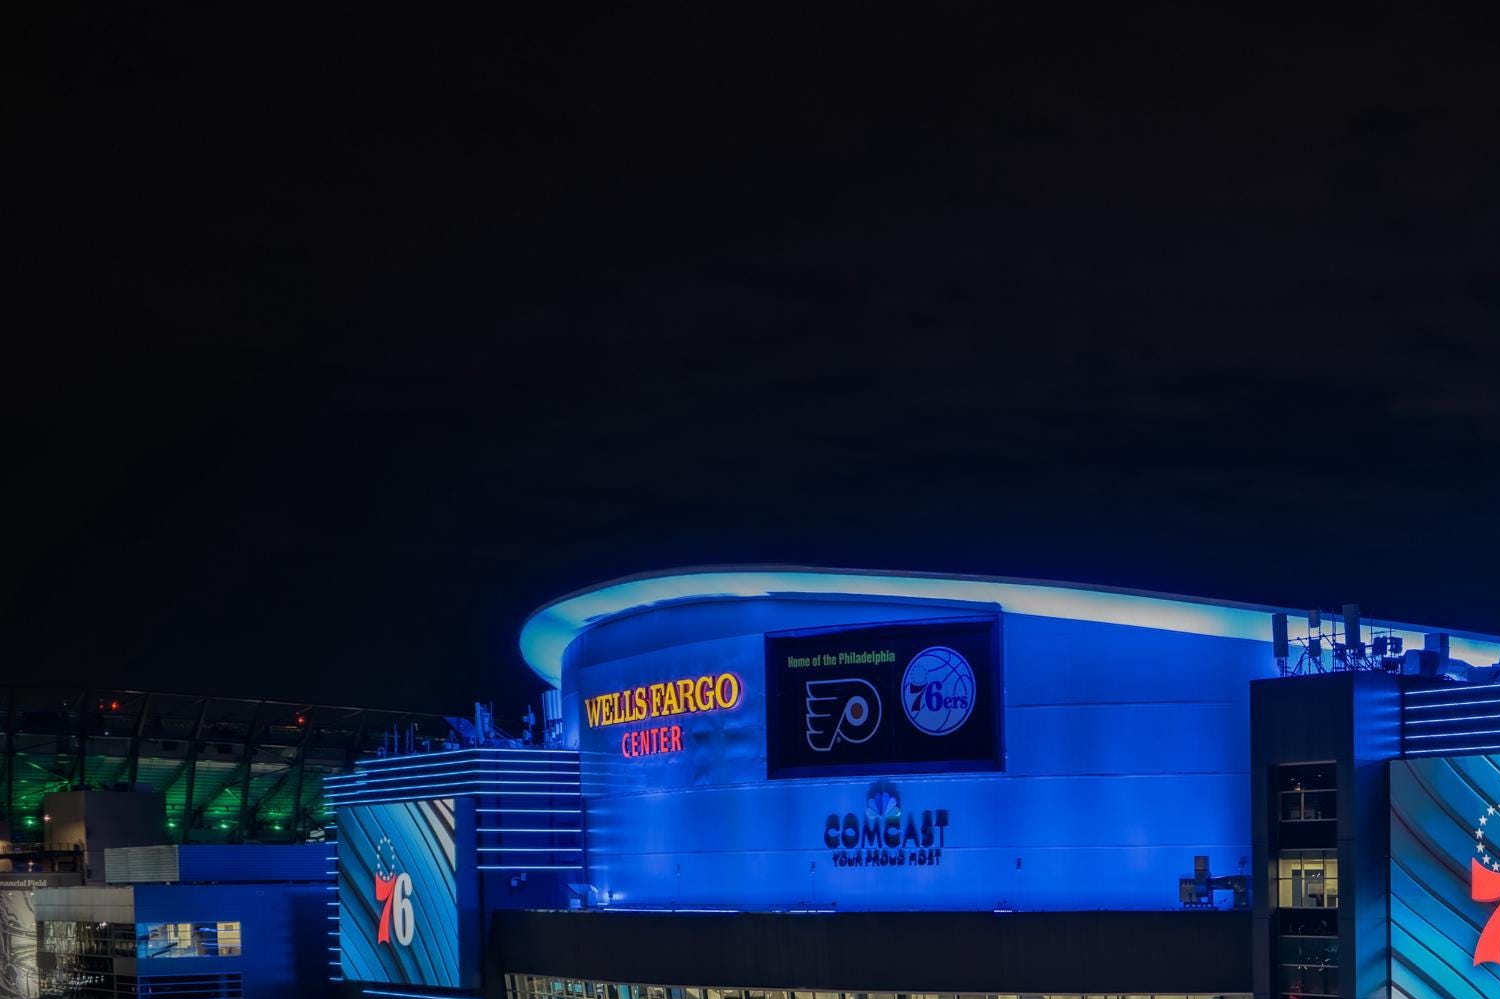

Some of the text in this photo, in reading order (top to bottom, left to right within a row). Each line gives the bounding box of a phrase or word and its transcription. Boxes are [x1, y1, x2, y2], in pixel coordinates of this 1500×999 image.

[788, 650, 896, 668] Home of the Philadelphia
[585, 673, 740, 728] WELLS FARGO
[909, 680, 969, 713] 76ers
[621, 725, 683, 759] CENTER
[824, 809, 949, 849] COMCAST
[832, 850, 863, 867] YOUR
[865, 849, 905, 867] PROUD
[28, 879, 48, 887] Field
[375, 872, 415, 946] 76
